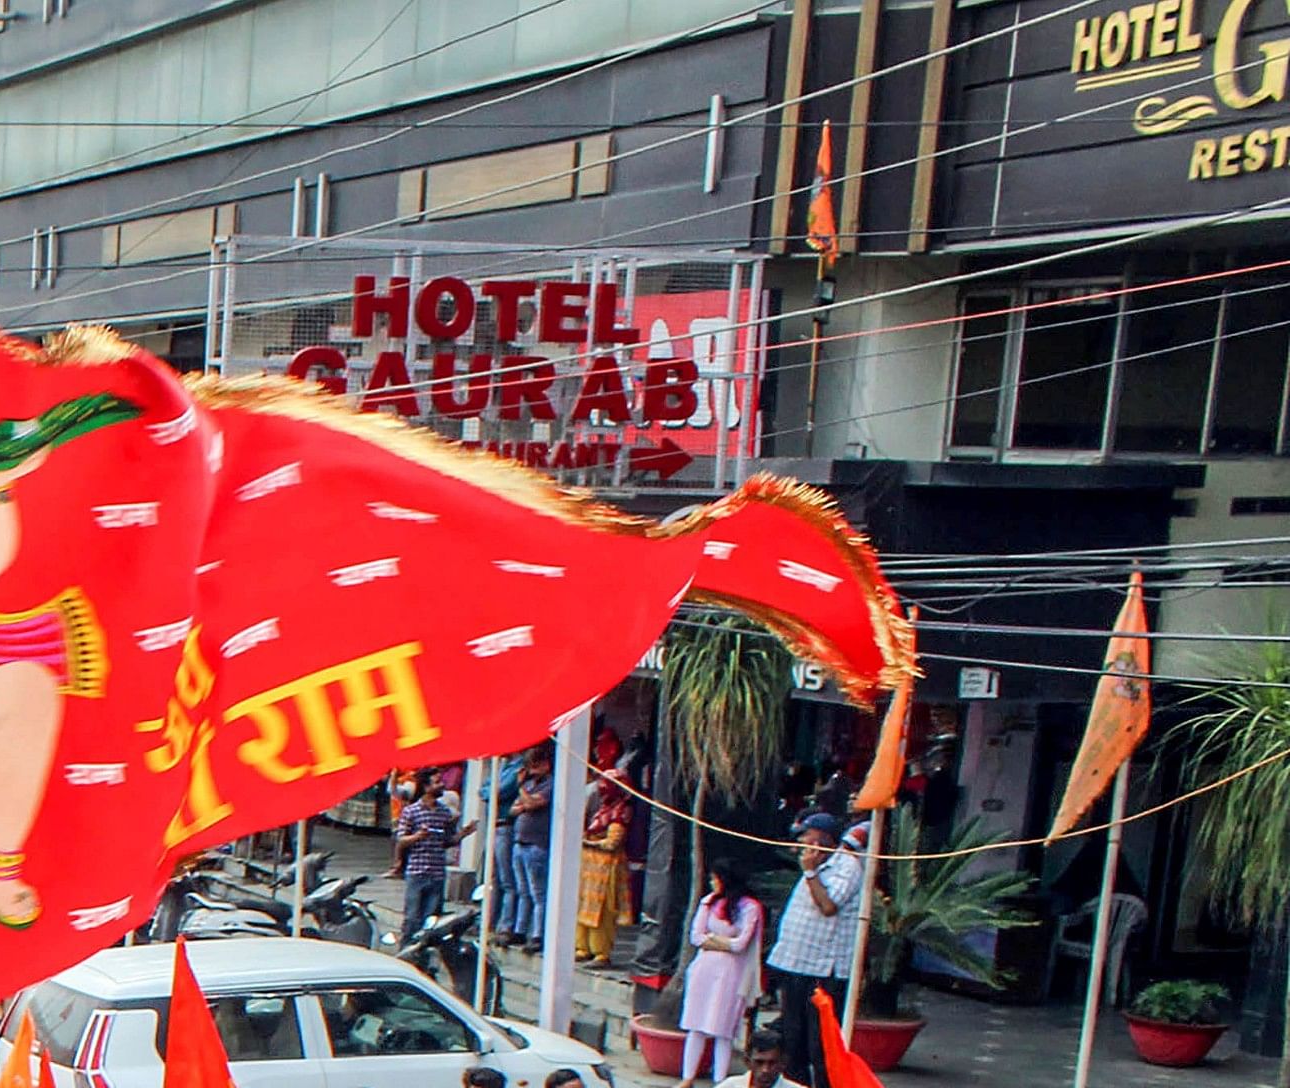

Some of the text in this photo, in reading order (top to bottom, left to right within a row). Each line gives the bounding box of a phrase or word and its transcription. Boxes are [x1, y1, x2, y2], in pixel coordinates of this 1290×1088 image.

[1071, 0, 1202, 73] HOTEL
[1188, 126, 1290, 181] REST
[353, 275, 639, 344] HOTEL
[288, 345, 699, 422] GAURAB
[93, 501, 159, 529] राम
[223, 641, 441, 784] राम
[68, 896, 132, 930] राम
